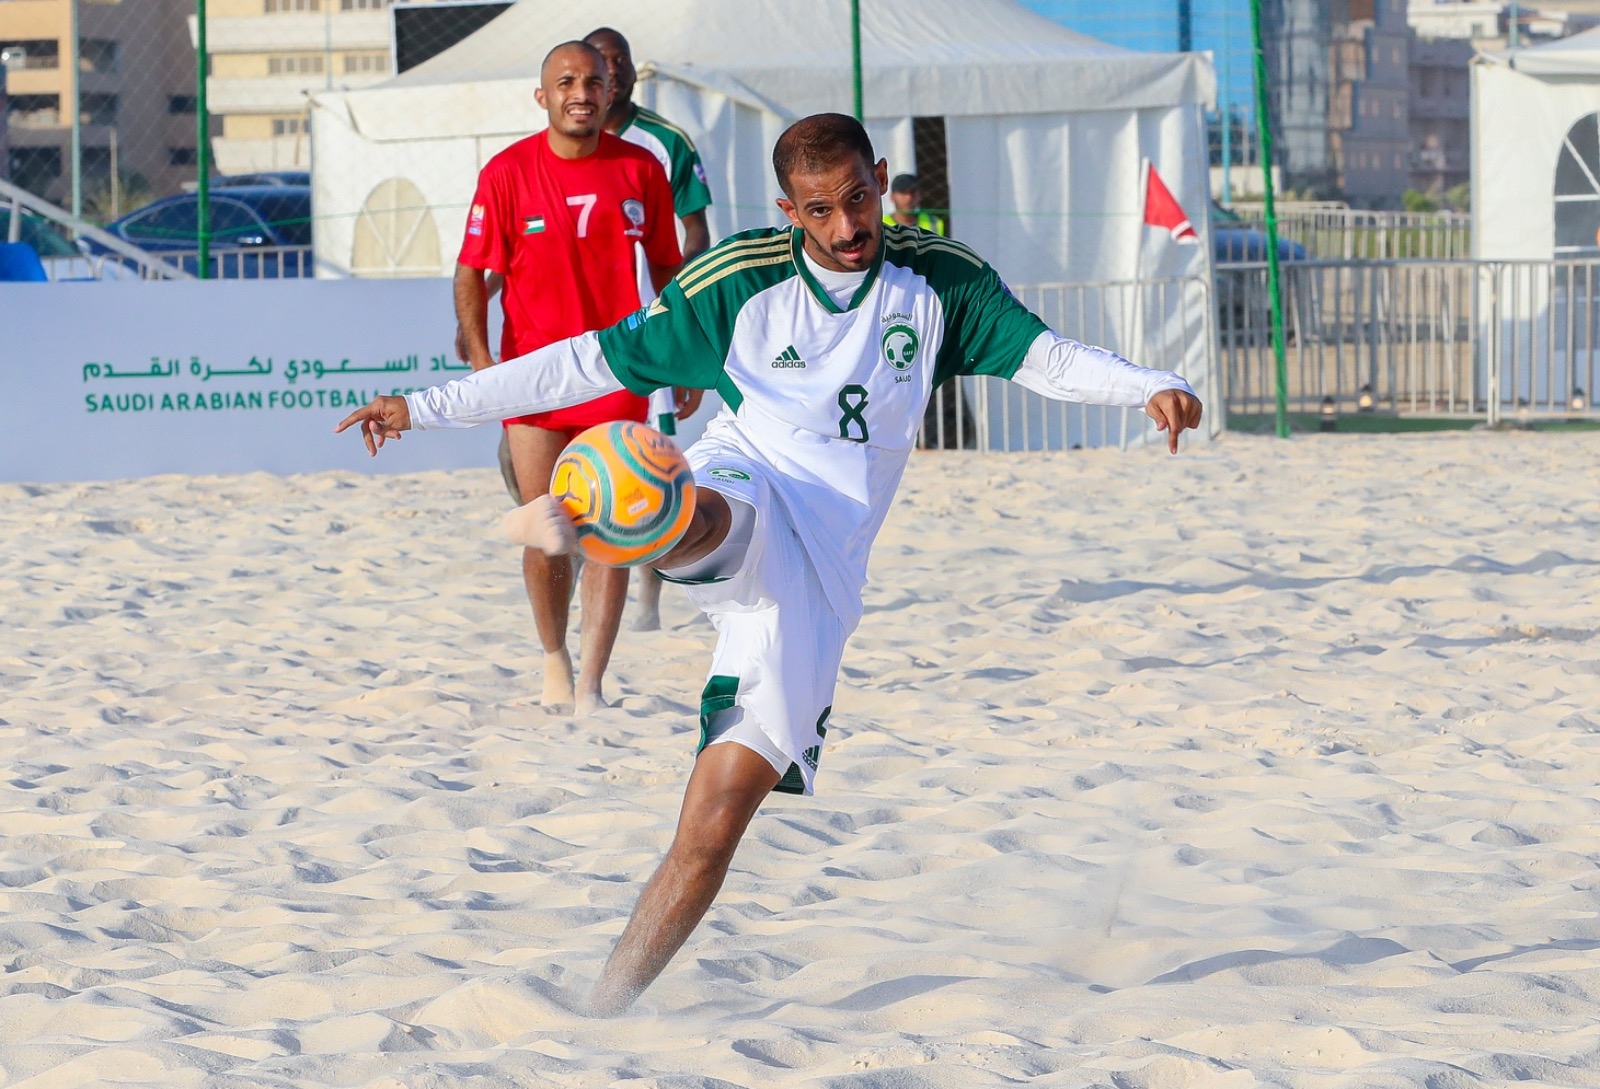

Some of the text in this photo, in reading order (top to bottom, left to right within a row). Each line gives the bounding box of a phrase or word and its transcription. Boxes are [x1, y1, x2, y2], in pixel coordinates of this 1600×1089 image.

[566, 194, 597, 238] 7
[83, 356, 179, 382] القدم
[190, 355, 272, 381] لكرة
[284, 354, 418, 384] السعودي
[771, 360, 806, 369] adidas
[85, 393, 154, 412] SAUDI
[160, 391, 262, 410] ARABIAN
[838, 384, 869, 443] 8
